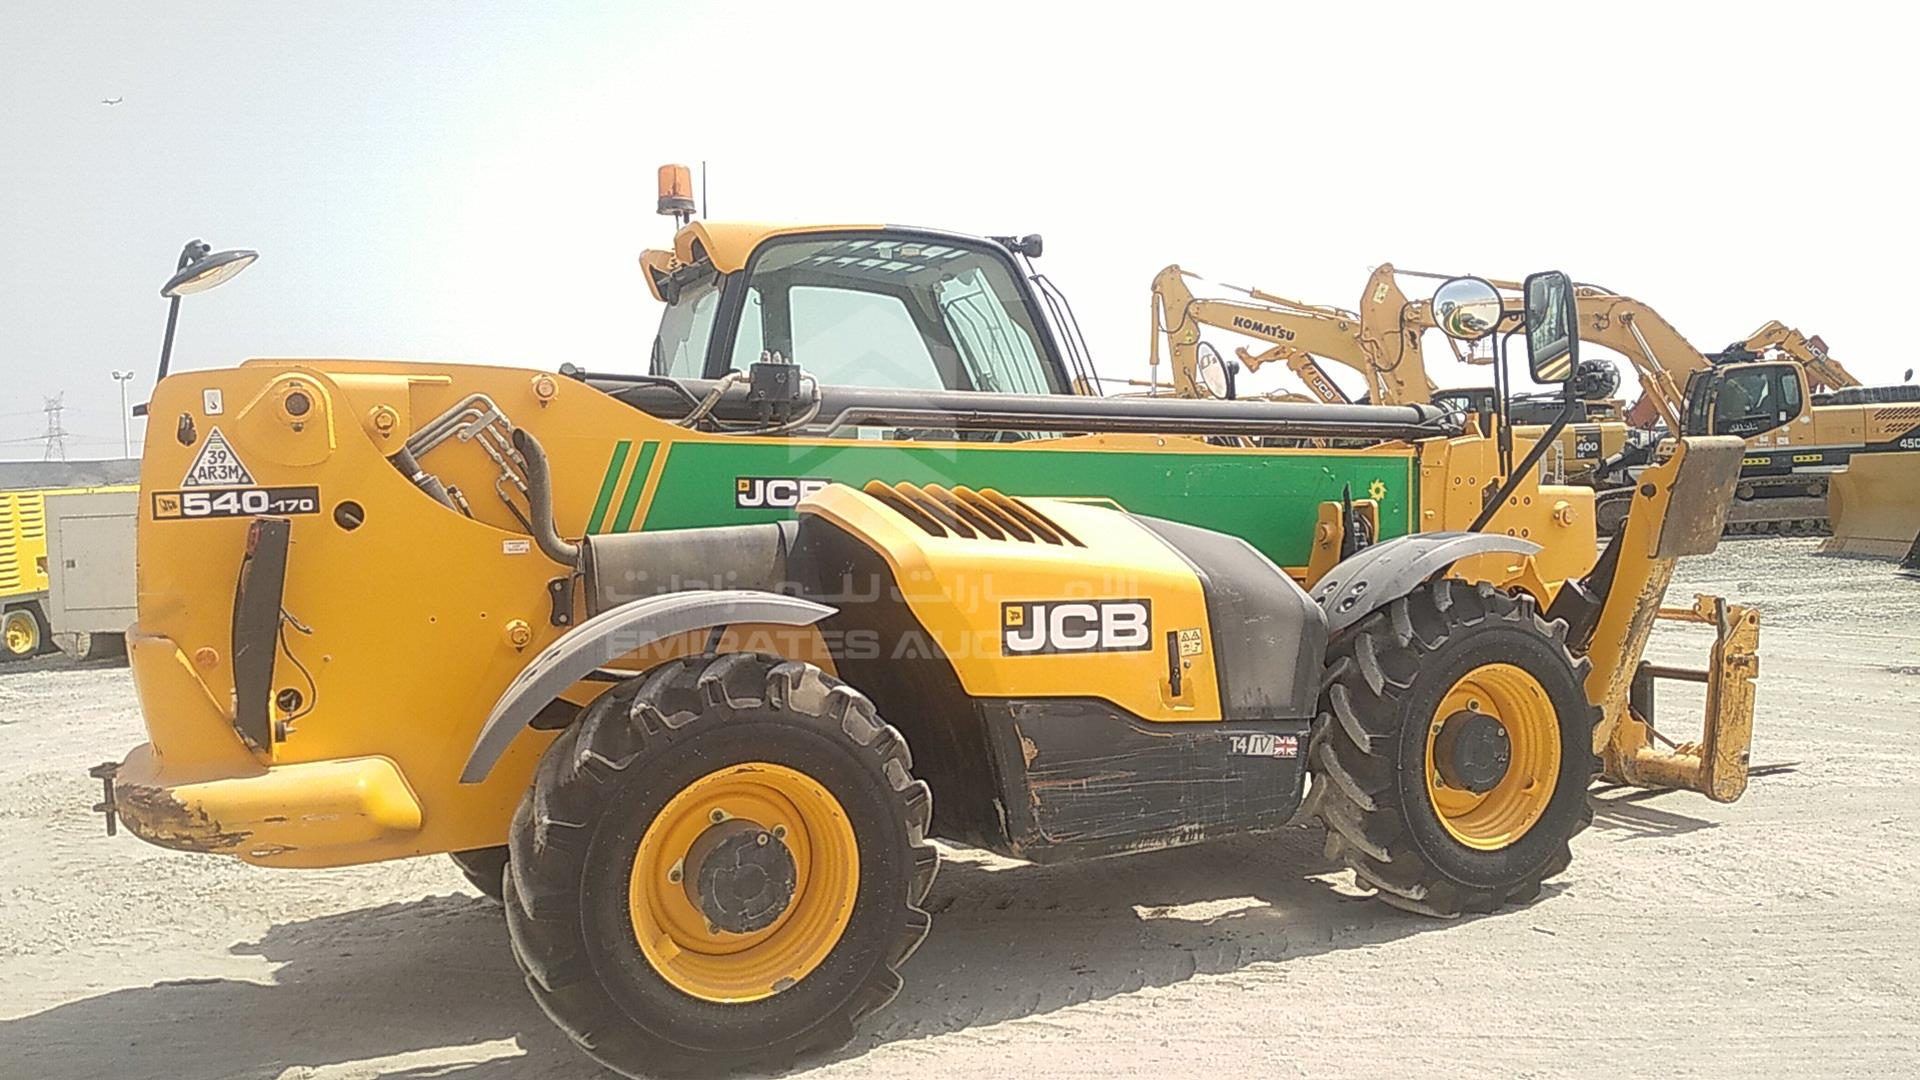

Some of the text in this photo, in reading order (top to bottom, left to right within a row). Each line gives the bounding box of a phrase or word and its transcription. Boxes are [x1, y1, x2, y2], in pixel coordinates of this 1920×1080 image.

[1233, 316, 1296, 341] KOMATSU
[1805, 340, 1827, 362] JCB
[1312, 377, 1335, 401] JCB
[207, 450, 228, 465] 39
[1577, 442, 1599, 452] 400
[197, 465, 240, 480] AR3M
[1006, 604, 1149, 652] JCB
